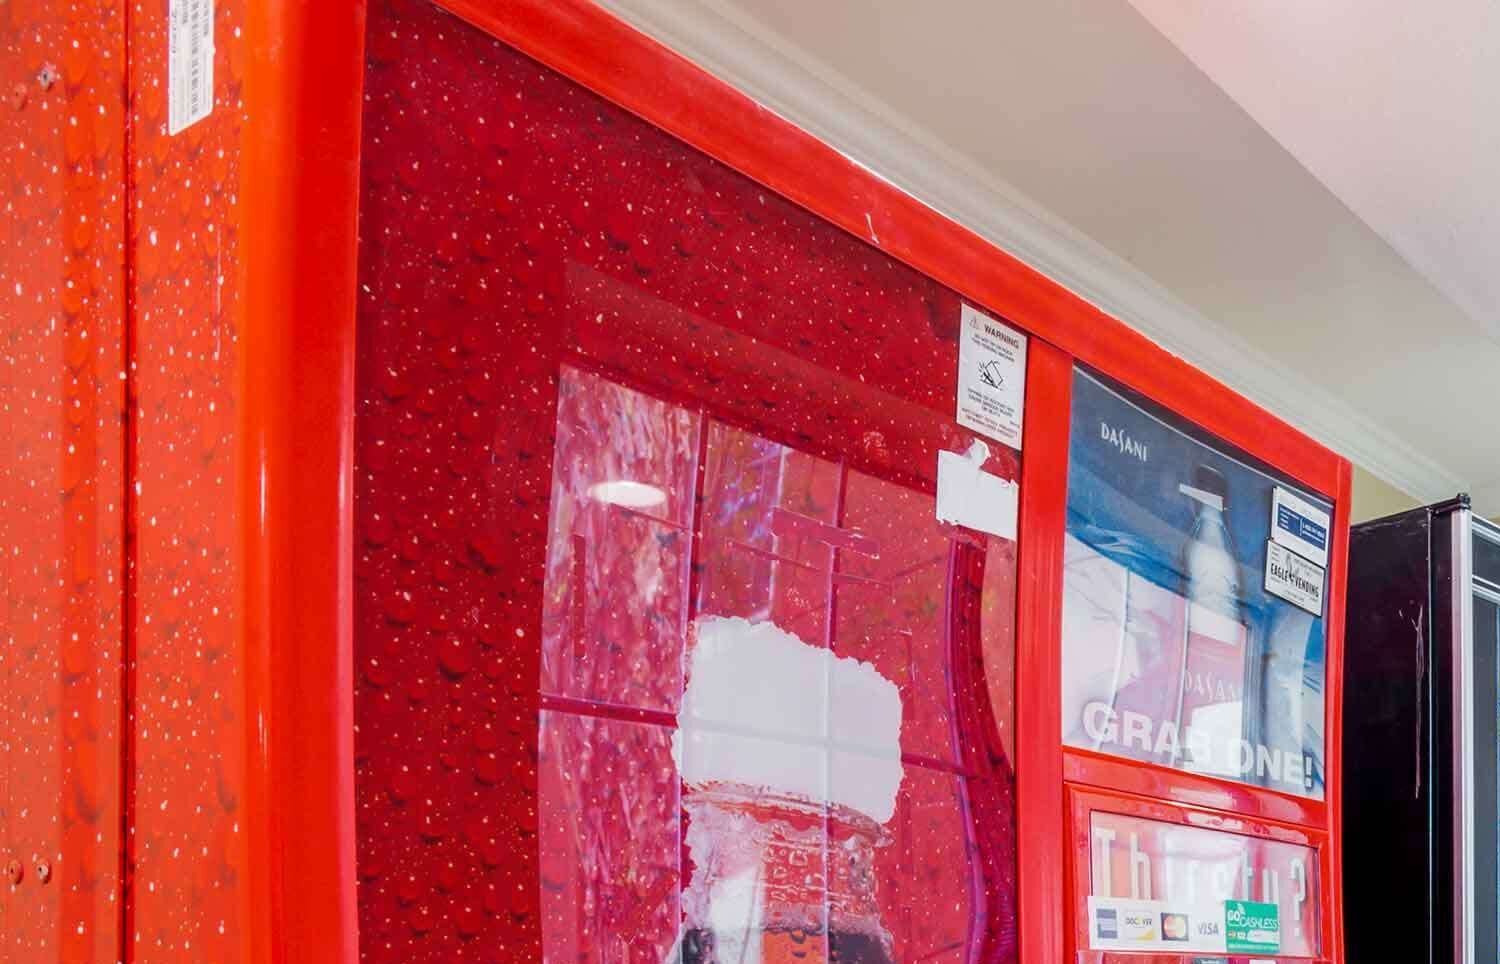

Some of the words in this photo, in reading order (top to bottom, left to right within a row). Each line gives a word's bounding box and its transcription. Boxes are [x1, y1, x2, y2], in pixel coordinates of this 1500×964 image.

[984, 324, 1019, 349] WARNING
[1101, 422, 1148, 463] DASANI
[1270, 563, 1288, 582] EAGLE
[1295, 576, 1320, 598] VENDING
[1083, 702, 1213, 765] GRAB
[1229, 738, 1314, 789] ONE!
[1198, 923, 1219, 936] VISA
[1227, 910, 1241, 922] GO
